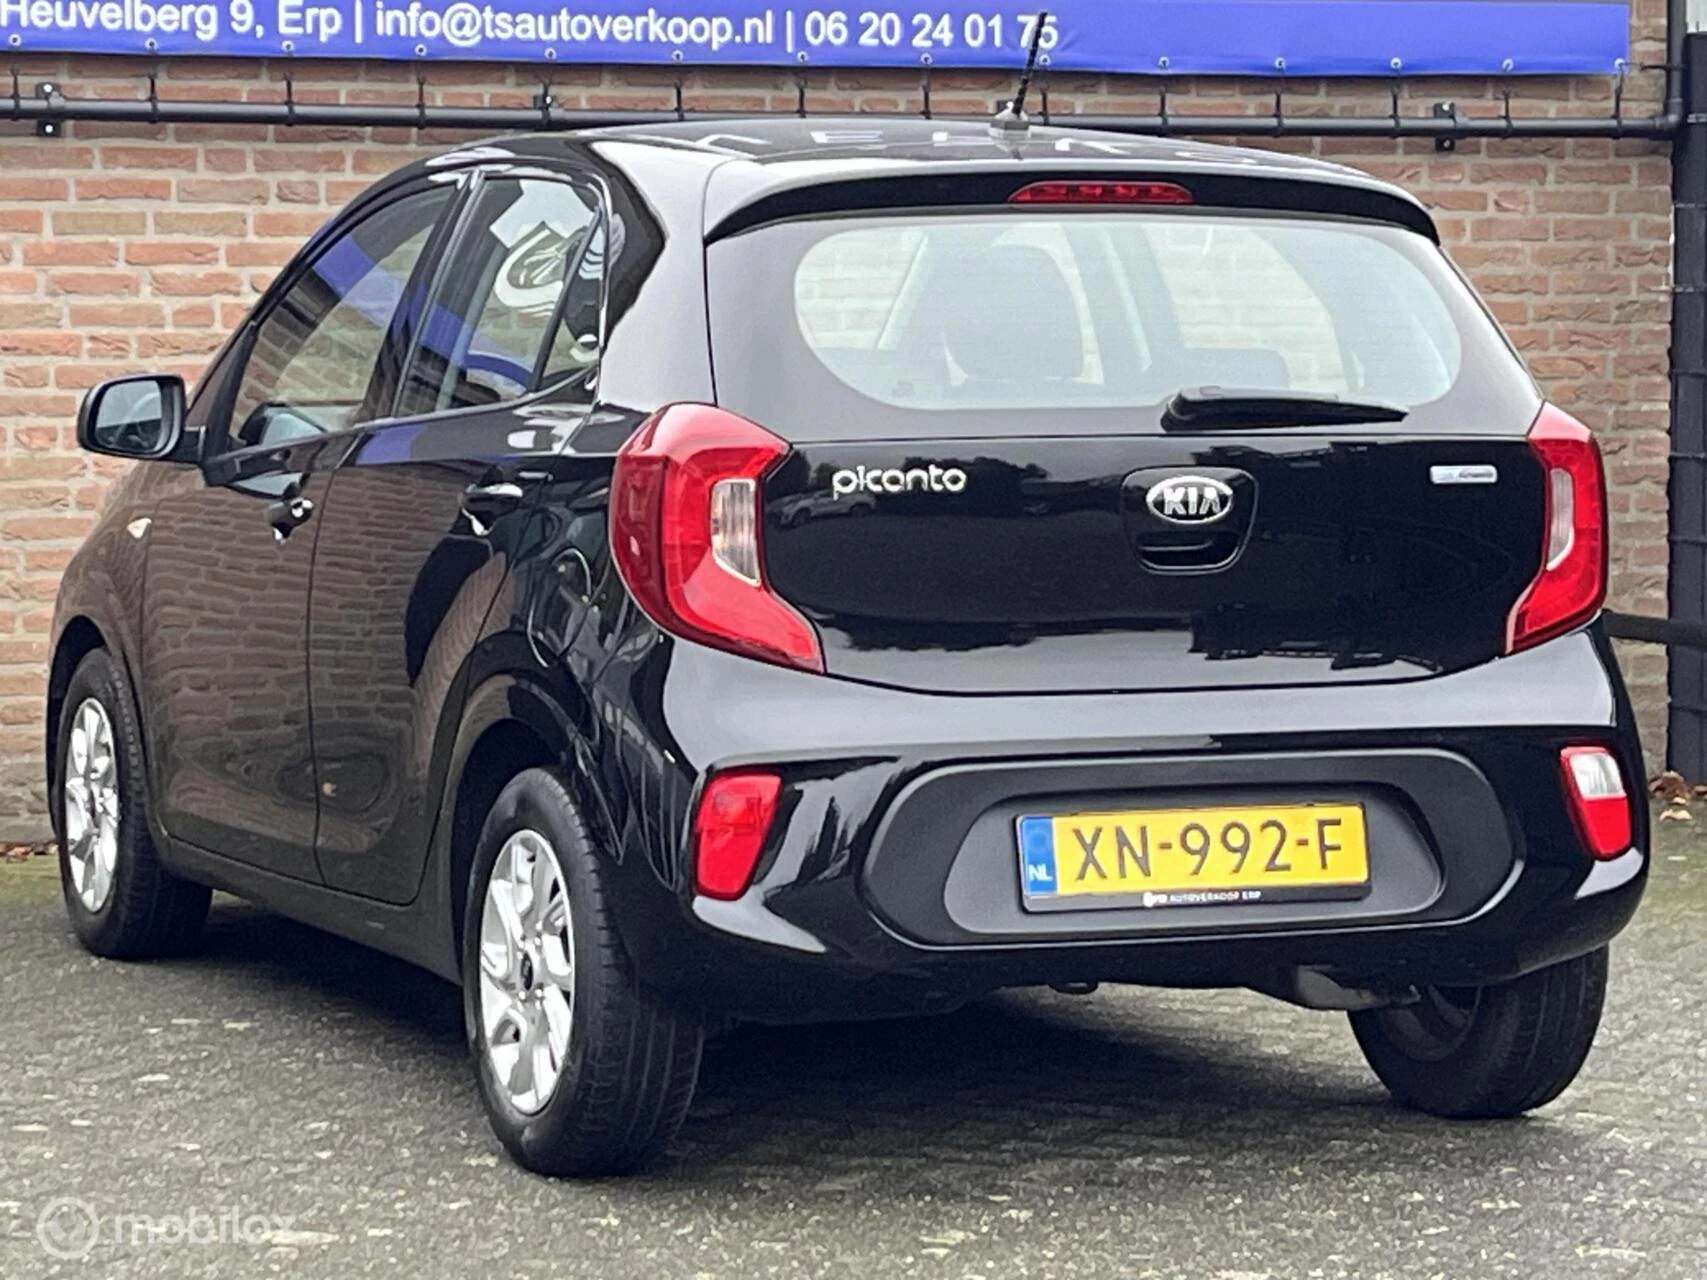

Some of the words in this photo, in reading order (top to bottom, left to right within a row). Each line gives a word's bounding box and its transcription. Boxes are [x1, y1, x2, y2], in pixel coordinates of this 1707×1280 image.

[0, 0, 218, 41] Heuvelberg
[229, 0, 264, 38] 9,
[278, 0, 342, 43] Erp
[376, 1, 773, 51] info@tsautoverkoop.nl
[804, 10, 849, 46] 06
[858, 11, 901, 46] 20
[911, 13, 954, 48] 24
[963, 14, 1002, 48] 01
[1016, 14, 1059, 49] 75
[832, 464, 967, 500] picanto
[1162, 486, 1222, 515] KIA
[1072, 817, 1343, 881] XN-992-F
[1028, 863, 1054, 881] NL
